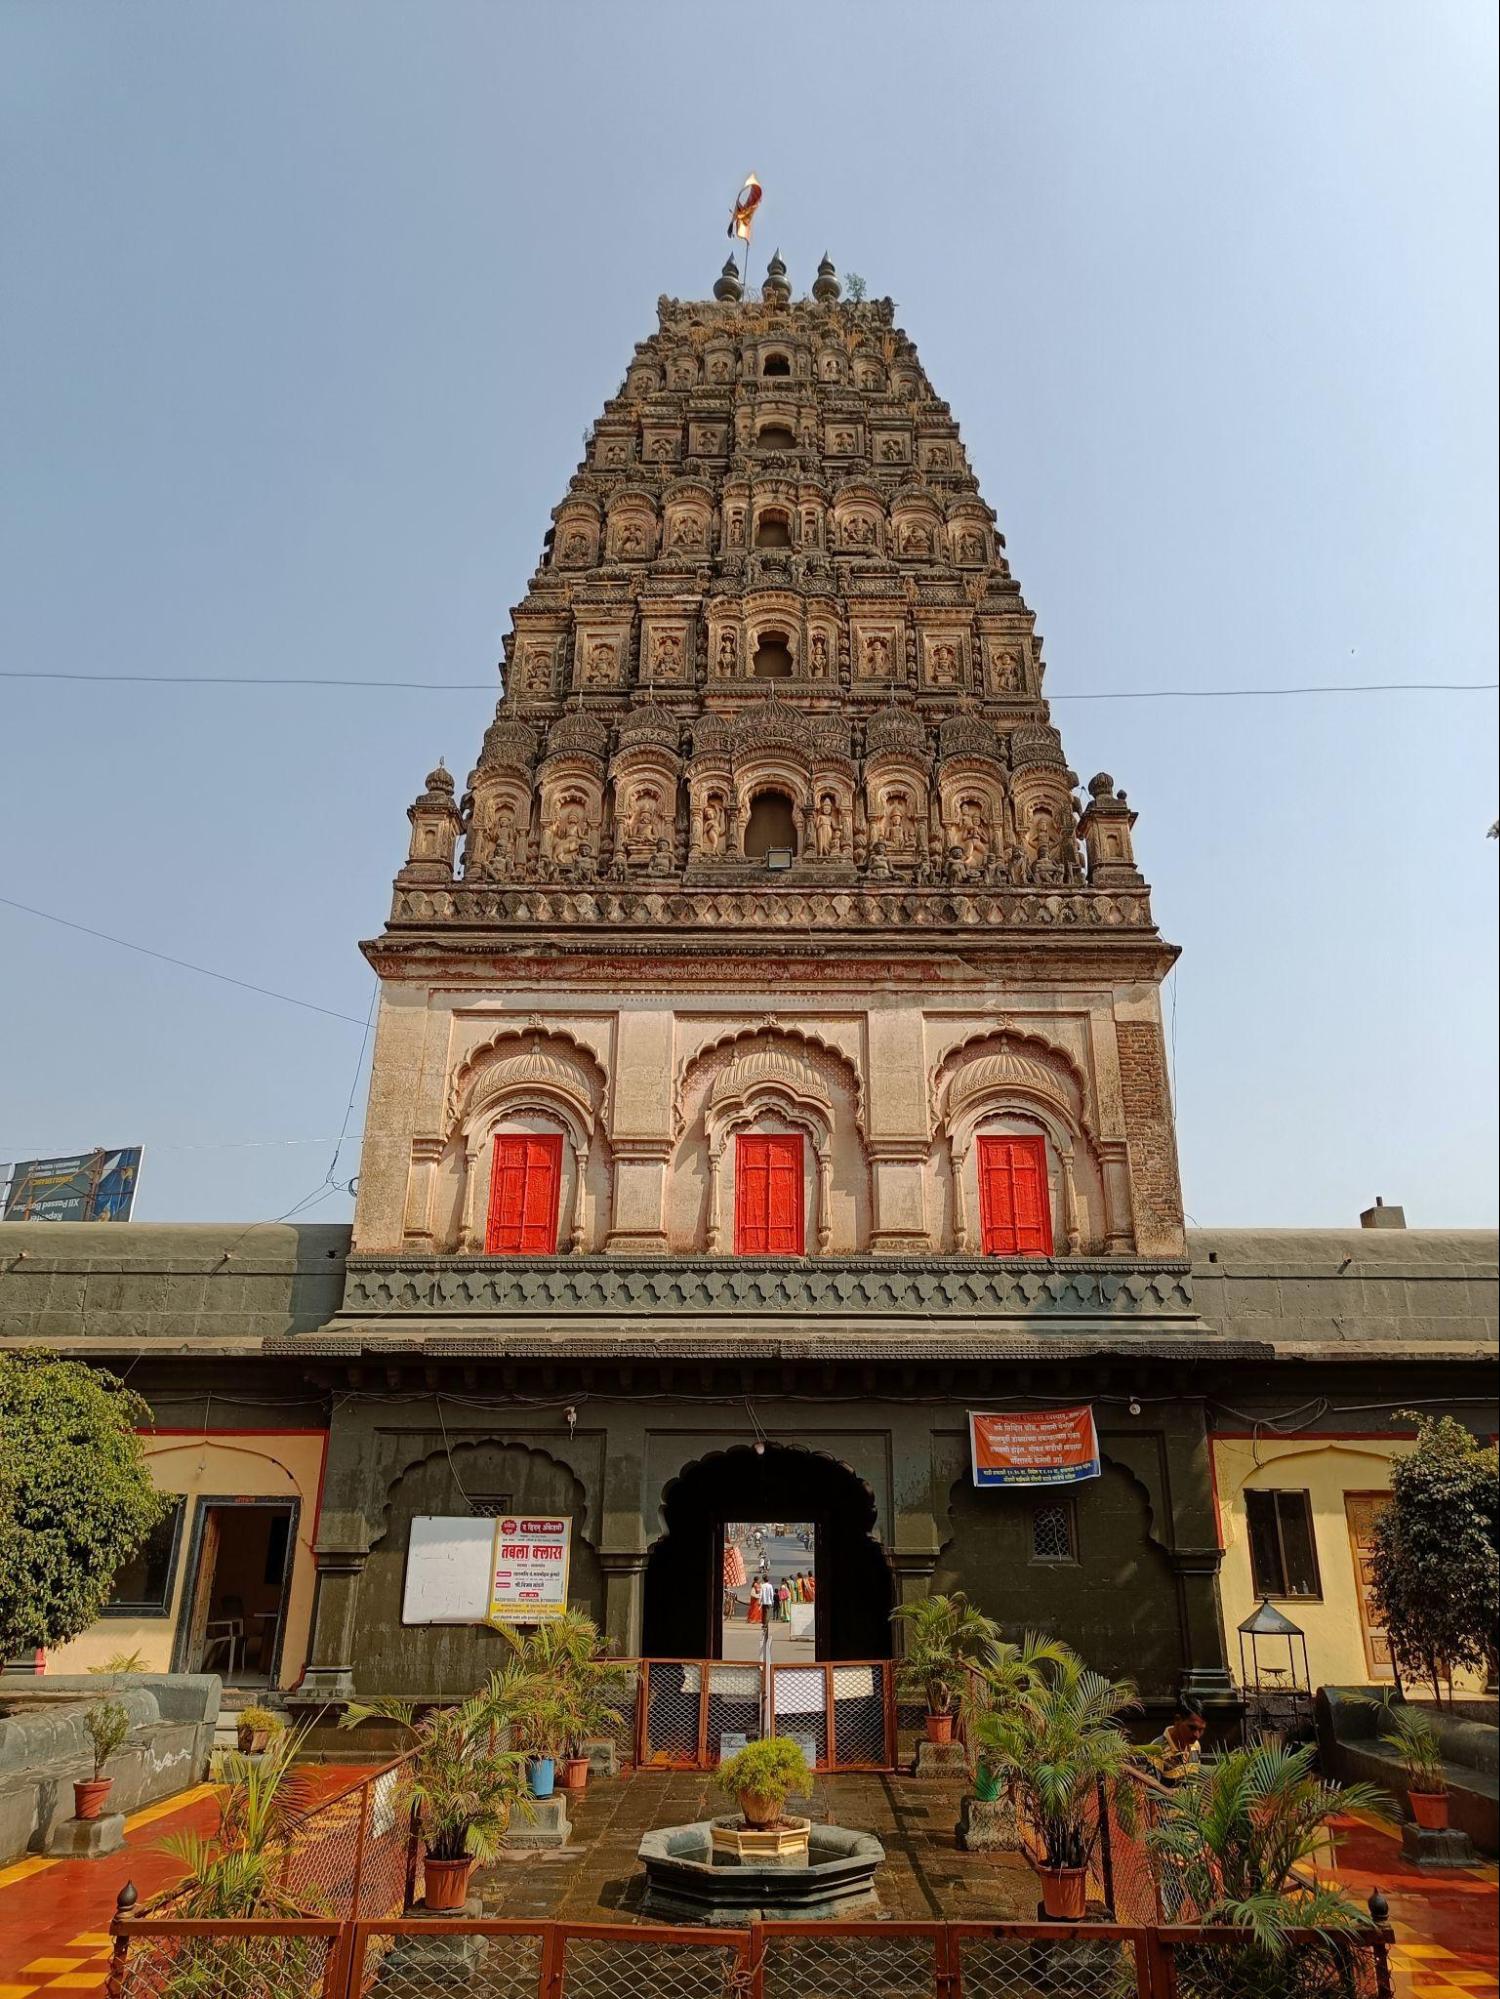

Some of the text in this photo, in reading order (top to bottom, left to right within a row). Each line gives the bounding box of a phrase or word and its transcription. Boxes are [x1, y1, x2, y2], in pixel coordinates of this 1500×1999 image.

[41, 1200, 68, 1211] Passed
[68, 1199, 79, 1208] XII
[502, 1545, 563, 1559] तबला क्लास
